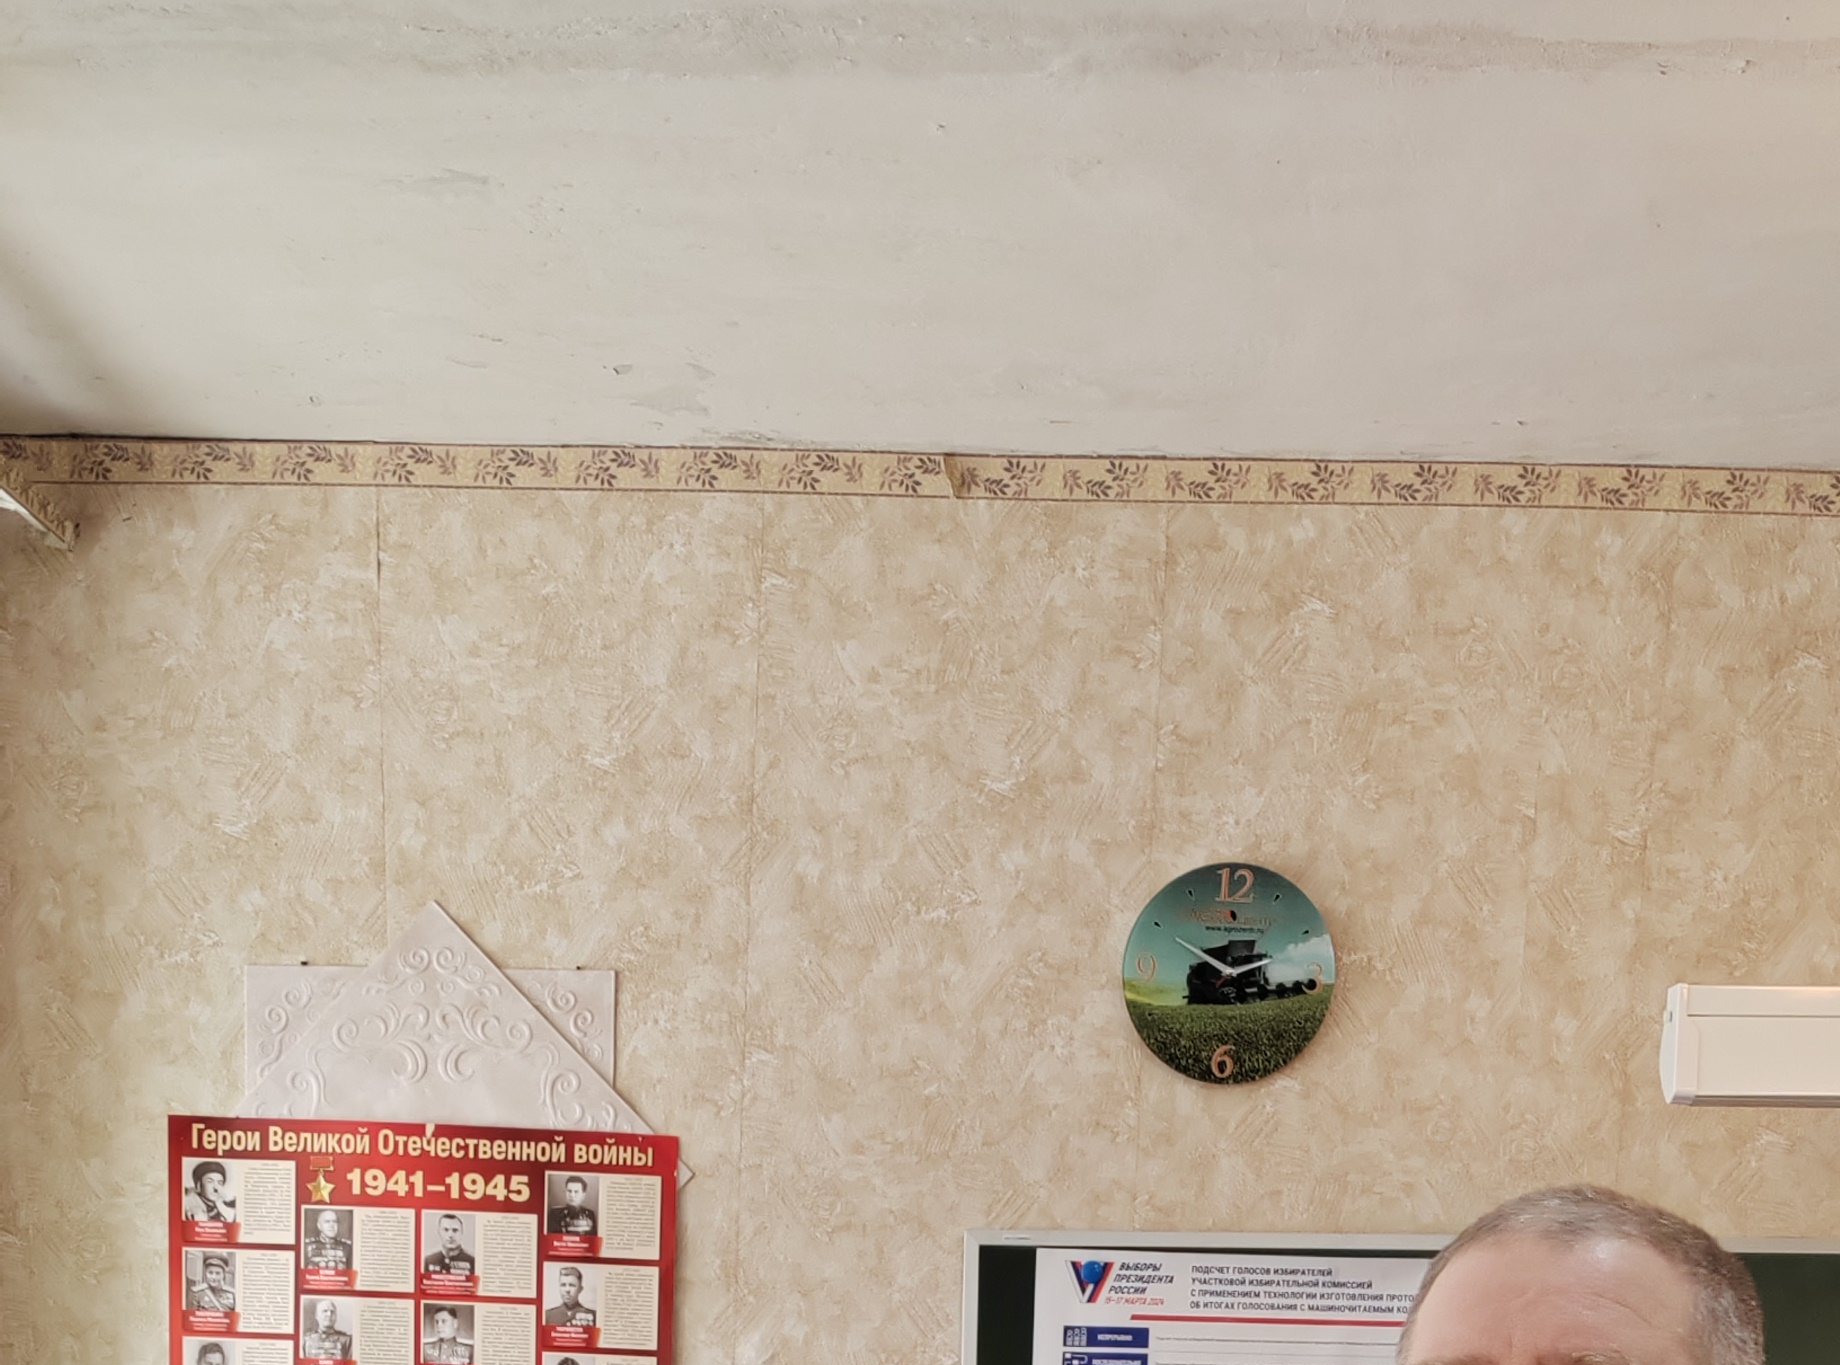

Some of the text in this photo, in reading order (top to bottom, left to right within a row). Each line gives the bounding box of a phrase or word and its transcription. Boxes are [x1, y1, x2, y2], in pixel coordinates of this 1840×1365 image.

[1215, 867, 1256, 903] 12
[1136, 952, 1157, 982] 9
[1302, 962, 1324, 995] 3
[1211, 1045, 1236, 1079] 6
[191, 1123, 653, 1167] Герои Великой Отечественной войны
[1119, 1262, 1162, 1272] ВЫБОРЫ
[1191, 1265, 1333, 1277] ПОДСЧЕТ ГОЛОСОВ ИЗБИРАТЕЛЕЙ
[1114, 1274, 1174, 1284] ПРЕЗИДЕНТА
[1191, 1277, 1373, 1290] УЧАСТКОВОЙ ИЗБИРАТЕЛЬНОЙ КОМИССИЕЙ
[1108, 1285, 1147, 1295] РОССИИ
[1190, 1289, 1197, 1297] С
[1198, 1289, 1260, 1298] ПРИМЕНЕНИЕМ
[1263, 1291, 1317, 1300] ТЕХНОЛОГИИ
[1319, 1292, 1384, 1301] ИЗГОТОВЛЕНИЯ
[1124, 1298, 1149, 1306] МАРТА
[1150, 1298, 1165, 1306] 2024
[1190, 1301, 1201, 1310] ОБ
[1203, 1301, 1236, 1310] ИТОГАХ
[1237, 1302, 1298, 1311] ГОЛОСОВАНИЯ
[1300, 1303, 1305, 1311] С
[1307, 1304, 1394, 1314] МАШИНОЧИТАЕМЫМ
